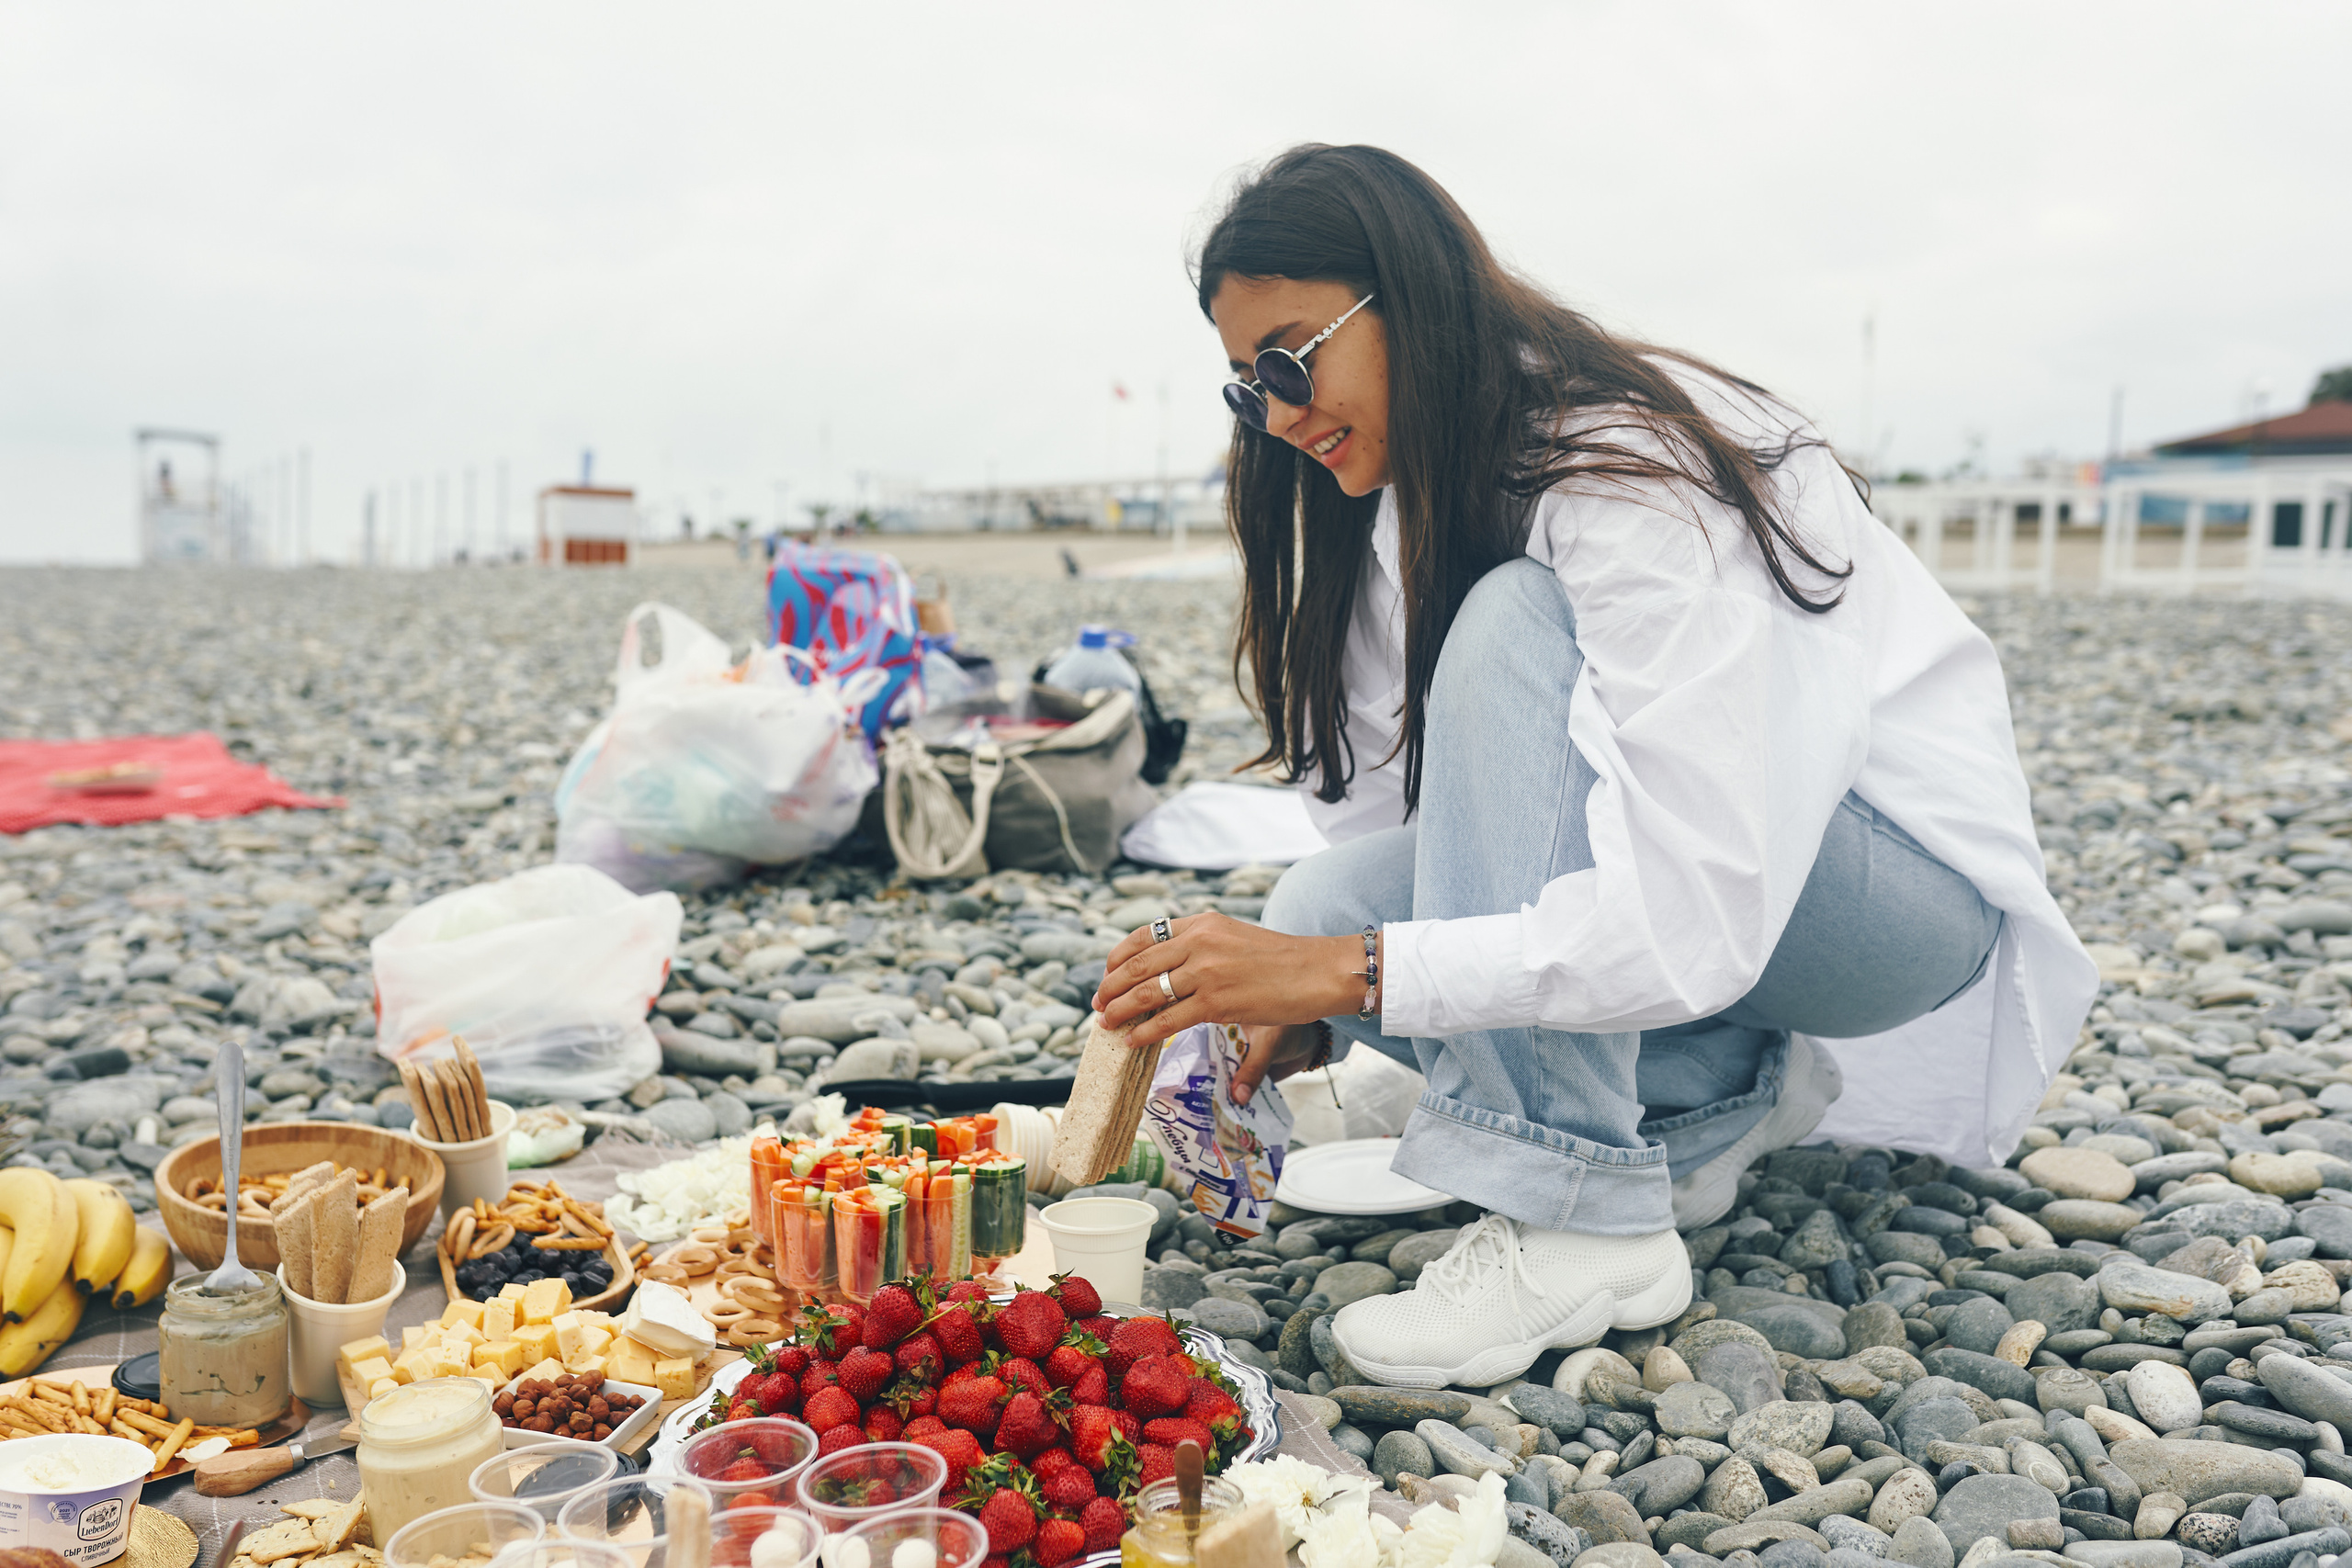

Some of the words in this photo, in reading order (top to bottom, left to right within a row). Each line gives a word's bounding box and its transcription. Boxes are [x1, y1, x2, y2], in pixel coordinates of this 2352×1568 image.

[1144, 1100, 1192, 1164] Хлебцы
[63, 1547, 82, 1558] СЫР
[84, 1531, 124, 1554] ТВОРОЖНЫЙ
[81, 1547, 110, 1562] СЛИВОЧНЫЙ
